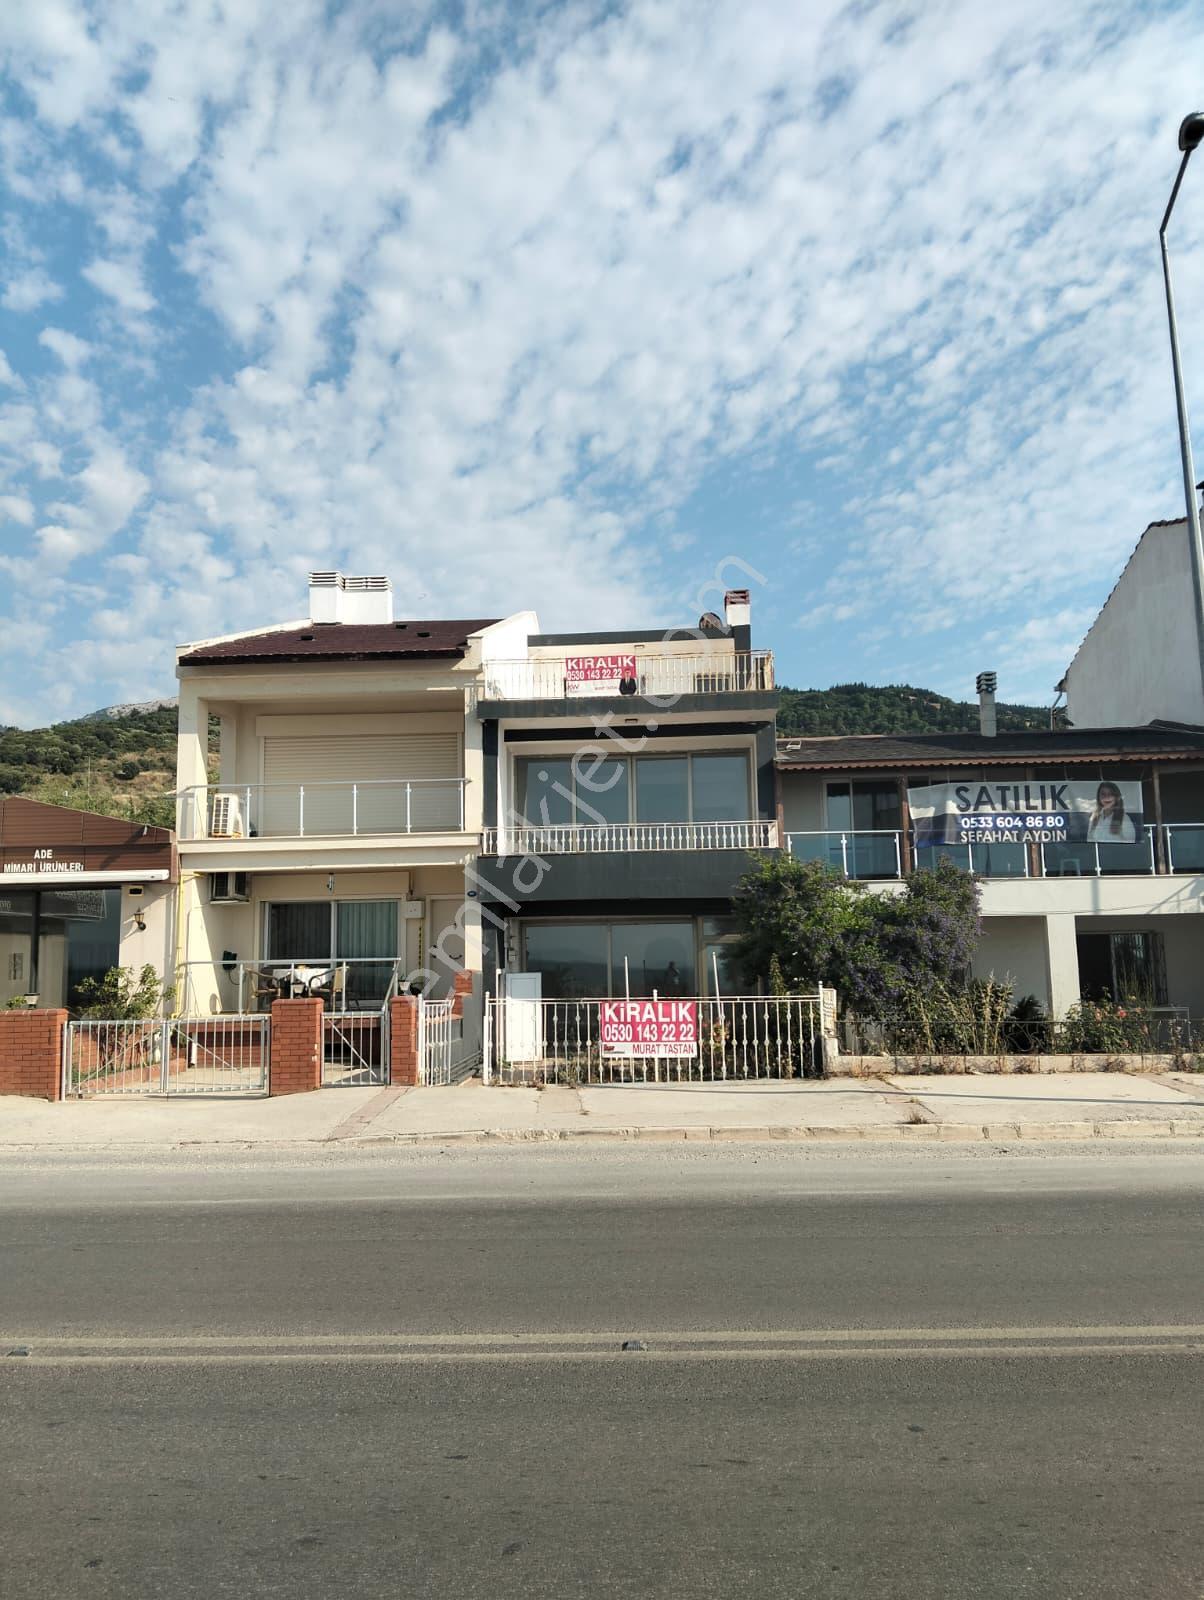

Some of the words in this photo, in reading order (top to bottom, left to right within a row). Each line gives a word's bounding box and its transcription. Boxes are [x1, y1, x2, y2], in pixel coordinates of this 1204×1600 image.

[567, 671, 585, 681] 0530
[587, 670, 601, 680] 143
[602, 669, 611, 679] 22
[613, 668, 622, 679] 22
[955, 784, 1070, 812] SATILIK
[961, 816, 993, 829] 0533
[996, 816, 1023, 829] 604
[1025, 816, 1043, 828] 86
[1046, 816, 1064, 828] 80
[960, 830, 1018, 843] SEFAHAT
[1022, 830, 1067, 843] AYDIN
[34, 849, 53, 859] ADE
[604, 1024, 632, 1042] 0530
[637, 1024, 658, 1042] 143
[661, 1024, 676, 1041] 22
[679, 1024, 694, 1041] 22
[632, 1044, 661, 1055] MURAT
